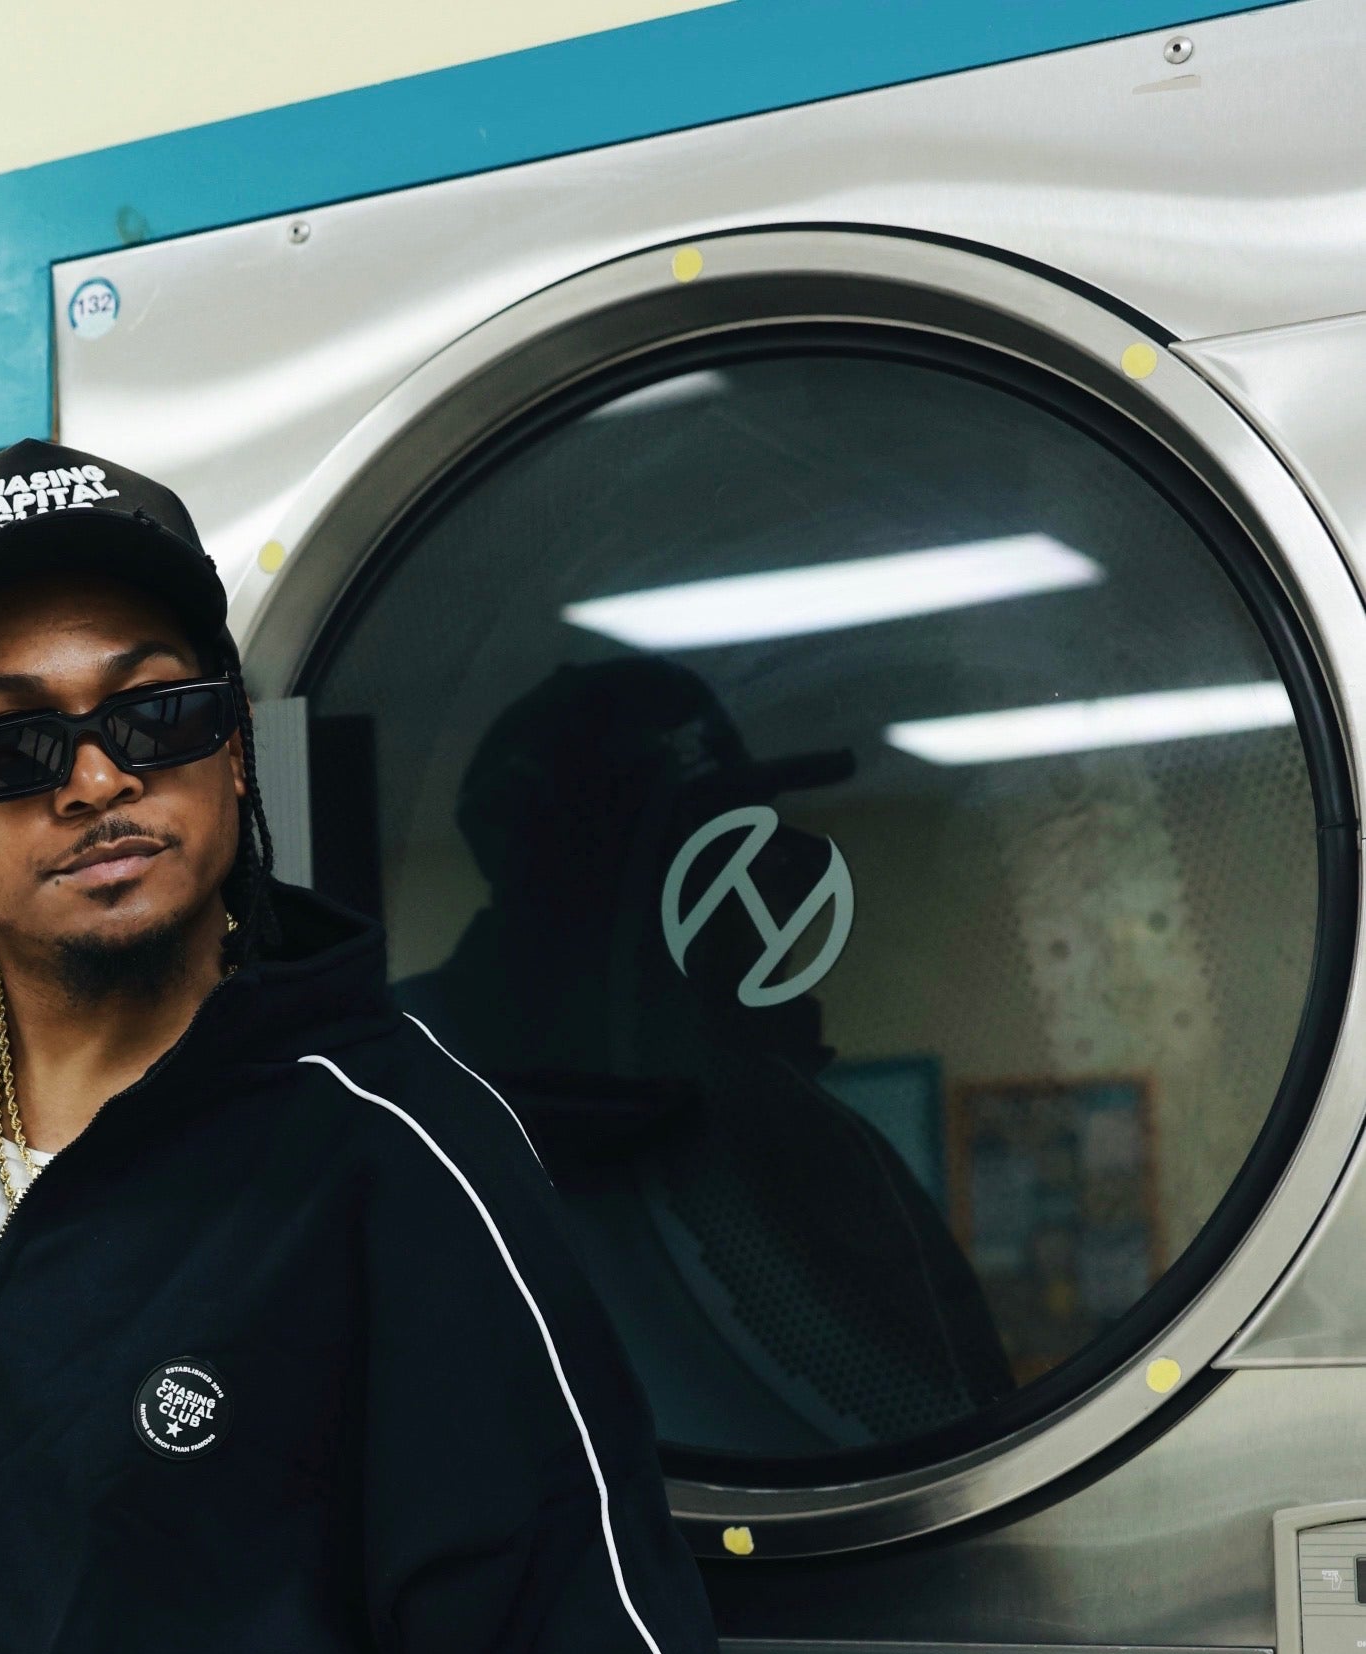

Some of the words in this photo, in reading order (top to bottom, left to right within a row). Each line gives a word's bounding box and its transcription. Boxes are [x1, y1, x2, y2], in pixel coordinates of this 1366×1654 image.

[78, 292, 112, 315] 132
[165, 1366, 213, 1384] ESTABLISHED
[156, 1386, 214, 1420] CAPITAL
[161, 1378, 216, 1409] CHASING
[159, 1402, 201, 1428] CLUB
[154, 1437, 171, 1449] RICH
[190, 1433, 216, 1451] FAMOUS
